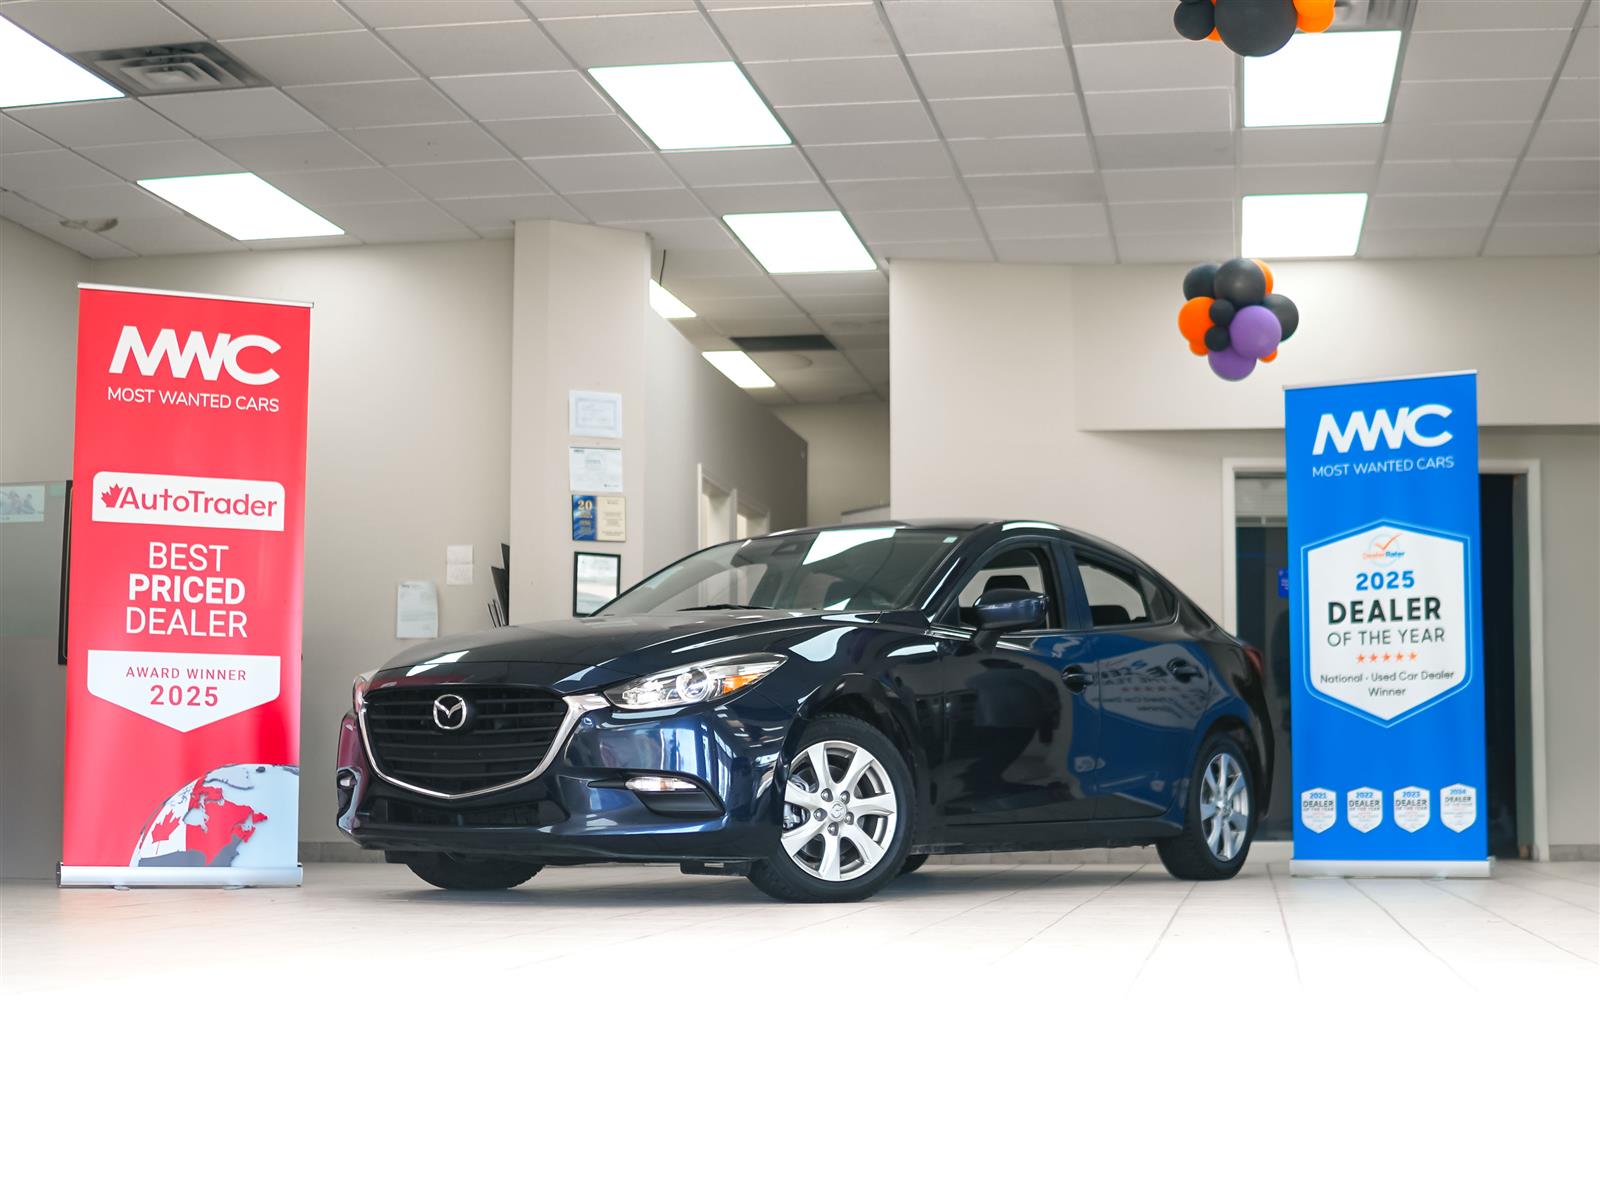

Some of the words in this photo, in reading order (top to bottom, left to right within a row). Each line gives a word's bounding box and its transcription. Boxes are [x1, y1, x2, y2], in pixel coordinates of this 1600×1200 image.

[109, 325, 281, 385] MWC
[107, 386, 155, 403] MOST
[158, 389, 232, 409] WANTED
[235, 395, 280, 412] CARS
[1312, 404, 1453, 456] MWC
[1312, 463, 1350, 478] MOST
[1353, 459, 1414, 475] WANTED
[1416, 455, 1455, 470] CARS
[119, 486, 277, 517] AutoTrader
[577, 500, 593, 511] 20
[149, 541, 229, 572] BEST
[128, 573, 246, 605] PRICED
[1355, 570, 1415, 591] 2025
[125, 606, 248, 638] DEALER
[1327, 596, 1441, 625] DEALER
[1327, 631, 1352, 647] OF
[1358, 629, 1391, 645] THE
[1398, 627, 1445, 644] YEAR
[126, 666, 180, 679] AWARD
[187, 668, 246, 681] WINNER
[1320, 673, 1363, 684] National
[1371, 672, 1396, 682] Used
[1399, 670, 1418, 681] Car
[1421, 669, 1455, 681] Dealer
[150, 684, 218, 707] 2025
[1368, 687, 1406, 697] Winner
[1303, 800, 1334, 808] DEALER
[1349, 800, 1380, 808] DEALER
[1395, 799, 1427, 807] DEALER
